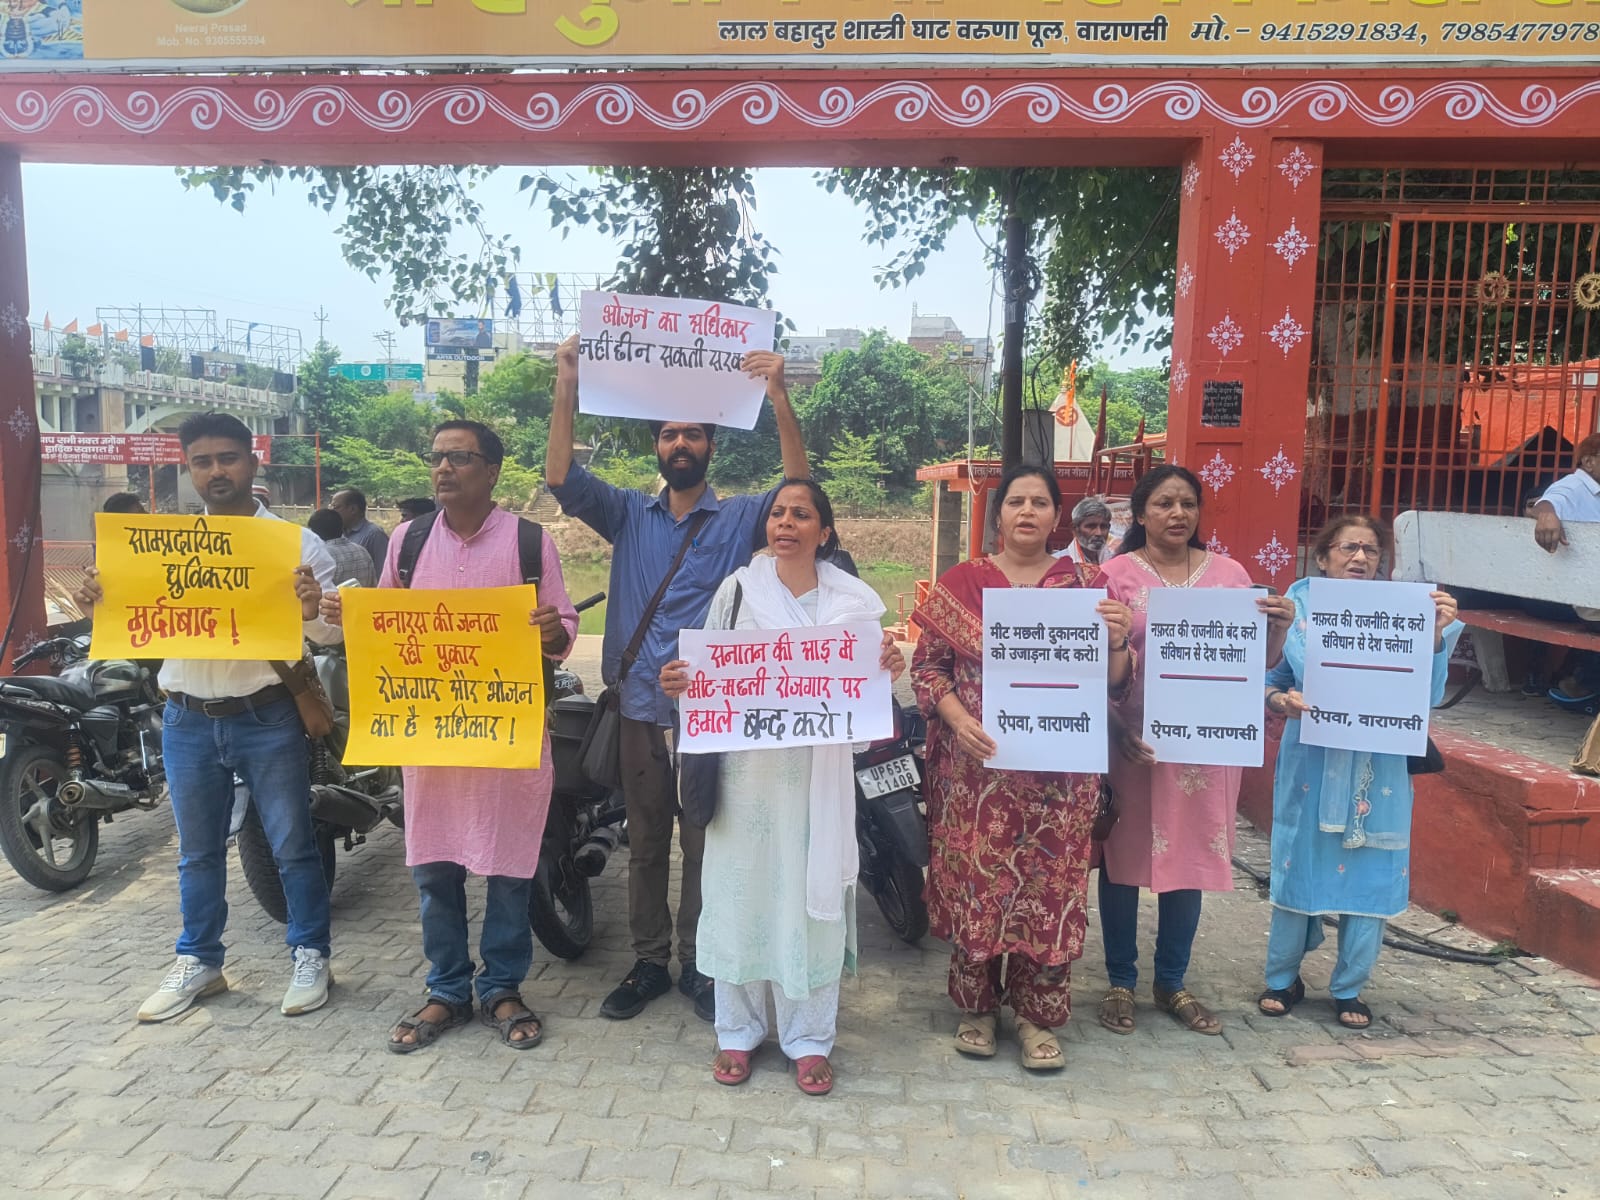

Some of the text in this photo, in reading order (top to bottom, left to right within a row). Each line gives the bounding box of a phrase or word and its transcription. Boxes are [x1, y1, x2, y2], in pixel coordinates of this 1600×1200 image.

[176, 24, 247, 34] Neeraj Prasad
[717, 19, 769, 42] लाल
[774, 19, 837, 48] बहादुर
[843, 13, 906, 41] शास्त्री
[912, 19, 951, 40] घाट
[957, 19, 1019, 41] वरुणा
[1076, 15, 1169, 42] वाराणसी
[1259, 22, 1428, 46] 9415291834,
[1441, 22, 1600, 41] 7985477978
[603, 295, 756, 344] भोजन का अधिकार
[579, 330, 613, 362] नहीं
[658, 338, 707, 368] सकती
[709, 349, 746, 372] सरक
[124, 517, 233, 556] साम्प्रदायिक
[162, 556, 255, 599] ध्रुविकरण
[126, 596, 221, 648] मुर्दाबाद
[372, 602, 500, 634] बनारस की जनता
[990, 622, 1100, 644] मीट मछली दुकानदारों
[1151, 619, 1258, 641] नफ़रत की राजनीति बंद करो
[1312, 609, 1425, 632] नफ़रत की राजनीति बंद करो
[394, 635, 482, 672] रही पुकार
[706, 642, 770, 668] सनातन
[772, 632, 794, 661] की
[838, 631, 858, 662] में
[990, 645, 1099, 664] को उजाड़ना बंद करो!
[1160, 642, 1246, 664] संविधान से देश चलेगा!
[1322, 630, 1413, 654] संविधान से देश चलेगा!
[376, 666, 538, 705] रोजगार और भोजन
[774, 666, 834, 698] रोजगार
[838, 676, 868, 698] पर
[370, 713, 399, 737] का
[404, 705, 420, 737] है
[434, 704, 504, 741] अधिकार
[686, 699, 740, 737] हमले
[743, 708, 788, 740] बन्द
[792, 702, 840, 738] करो
[998, 710, 1090, 735] ऐपवा, वाराणसी
[1151, 720, 1258, 741] ऐपवा, वाराणसी
[1309, 706, 1423, 731] ऐपवा, वाराणसी
[870, 758, 909, 781] UP65E
